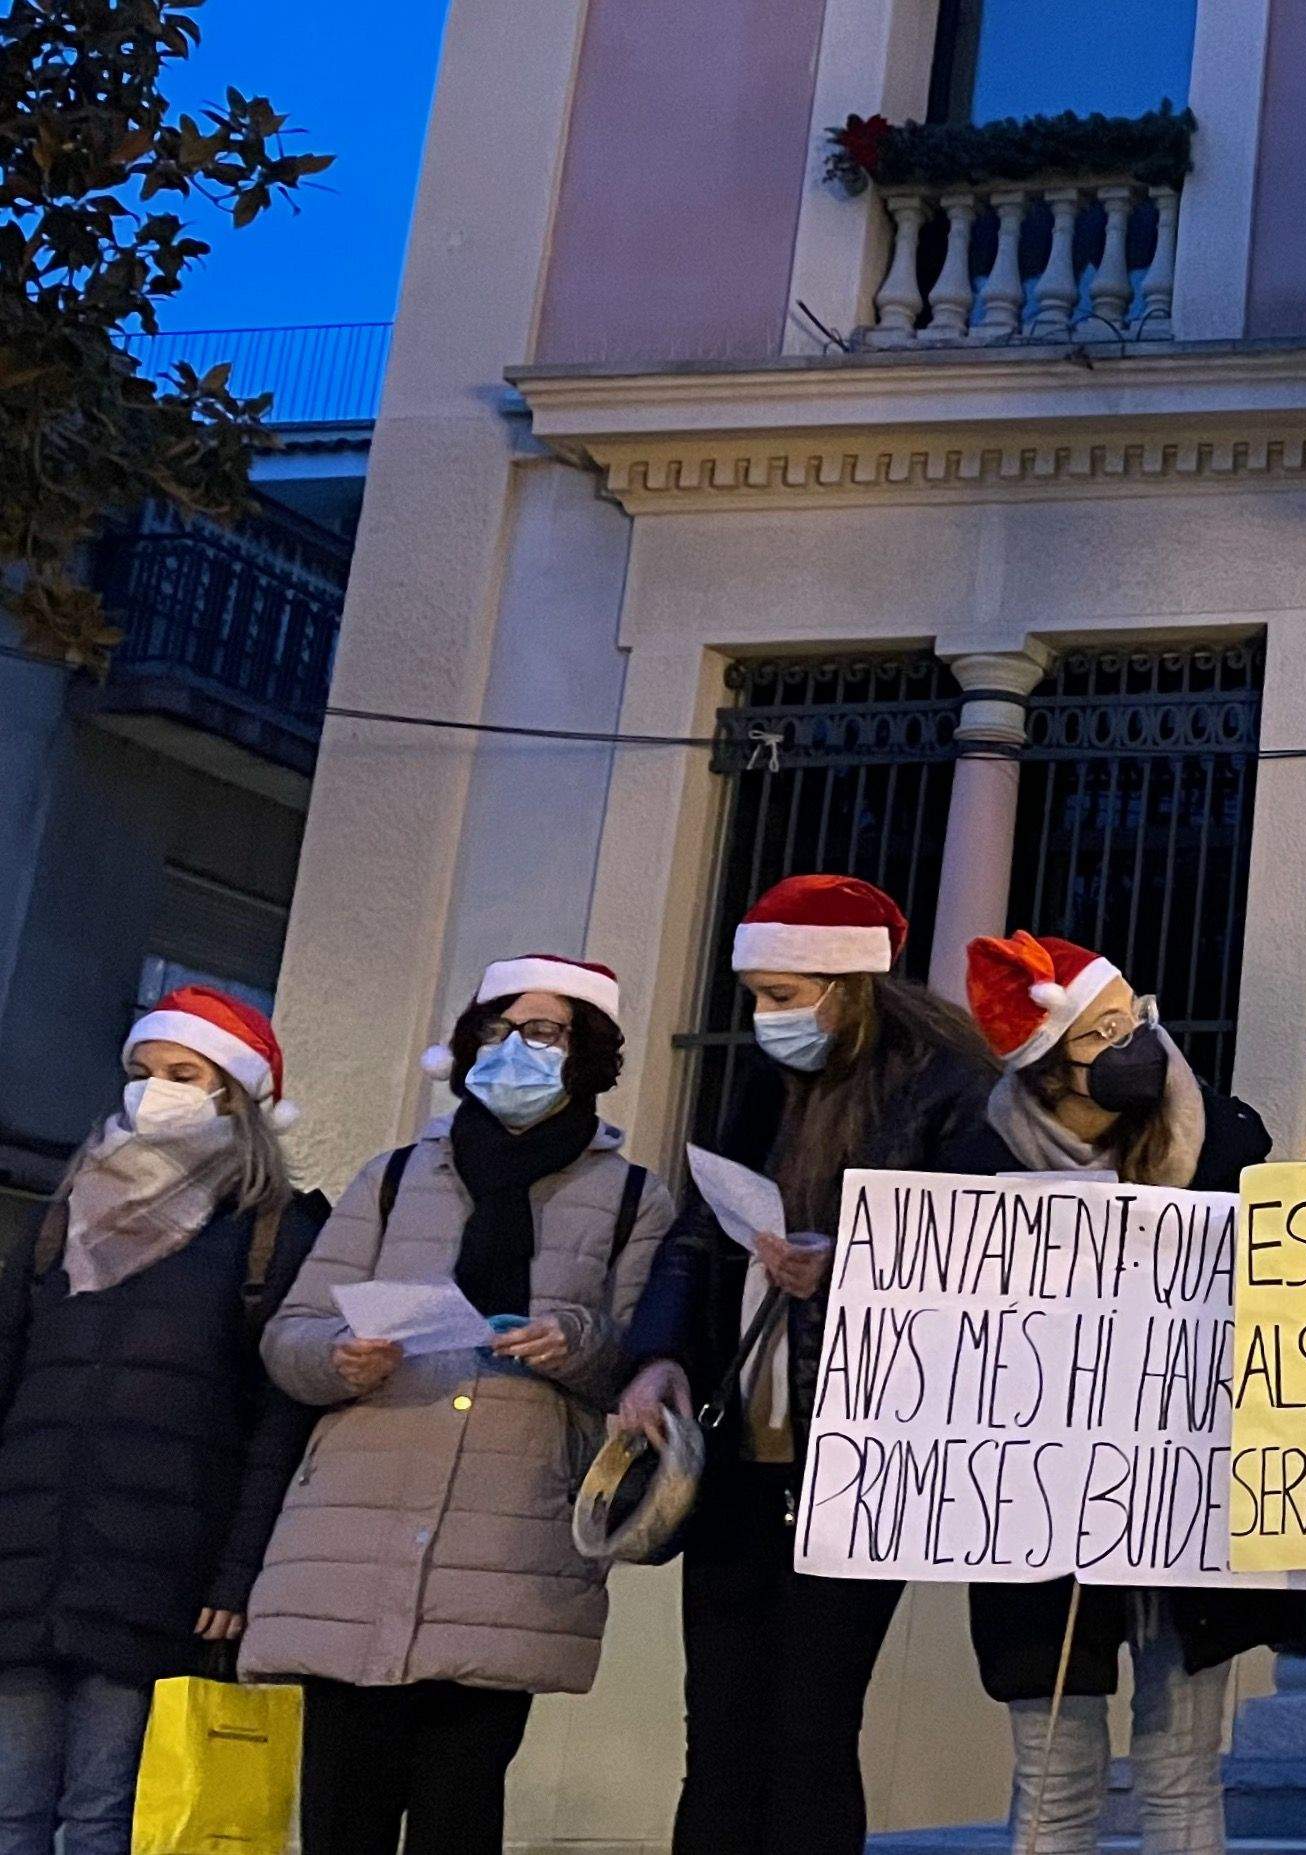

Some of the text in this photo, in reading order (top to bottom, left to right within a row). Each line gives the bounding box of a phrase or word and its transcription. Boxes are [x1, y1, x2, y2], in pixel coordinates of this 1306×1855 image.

[838, 1185, 1145, 1299] AJUNTAMENT:
[815, 1306, 939, 1423] ANYS
[946, 1301, 1047, 1428] MÉS
[803, 1432, 1232, 1572] PROMESES BUIDE
